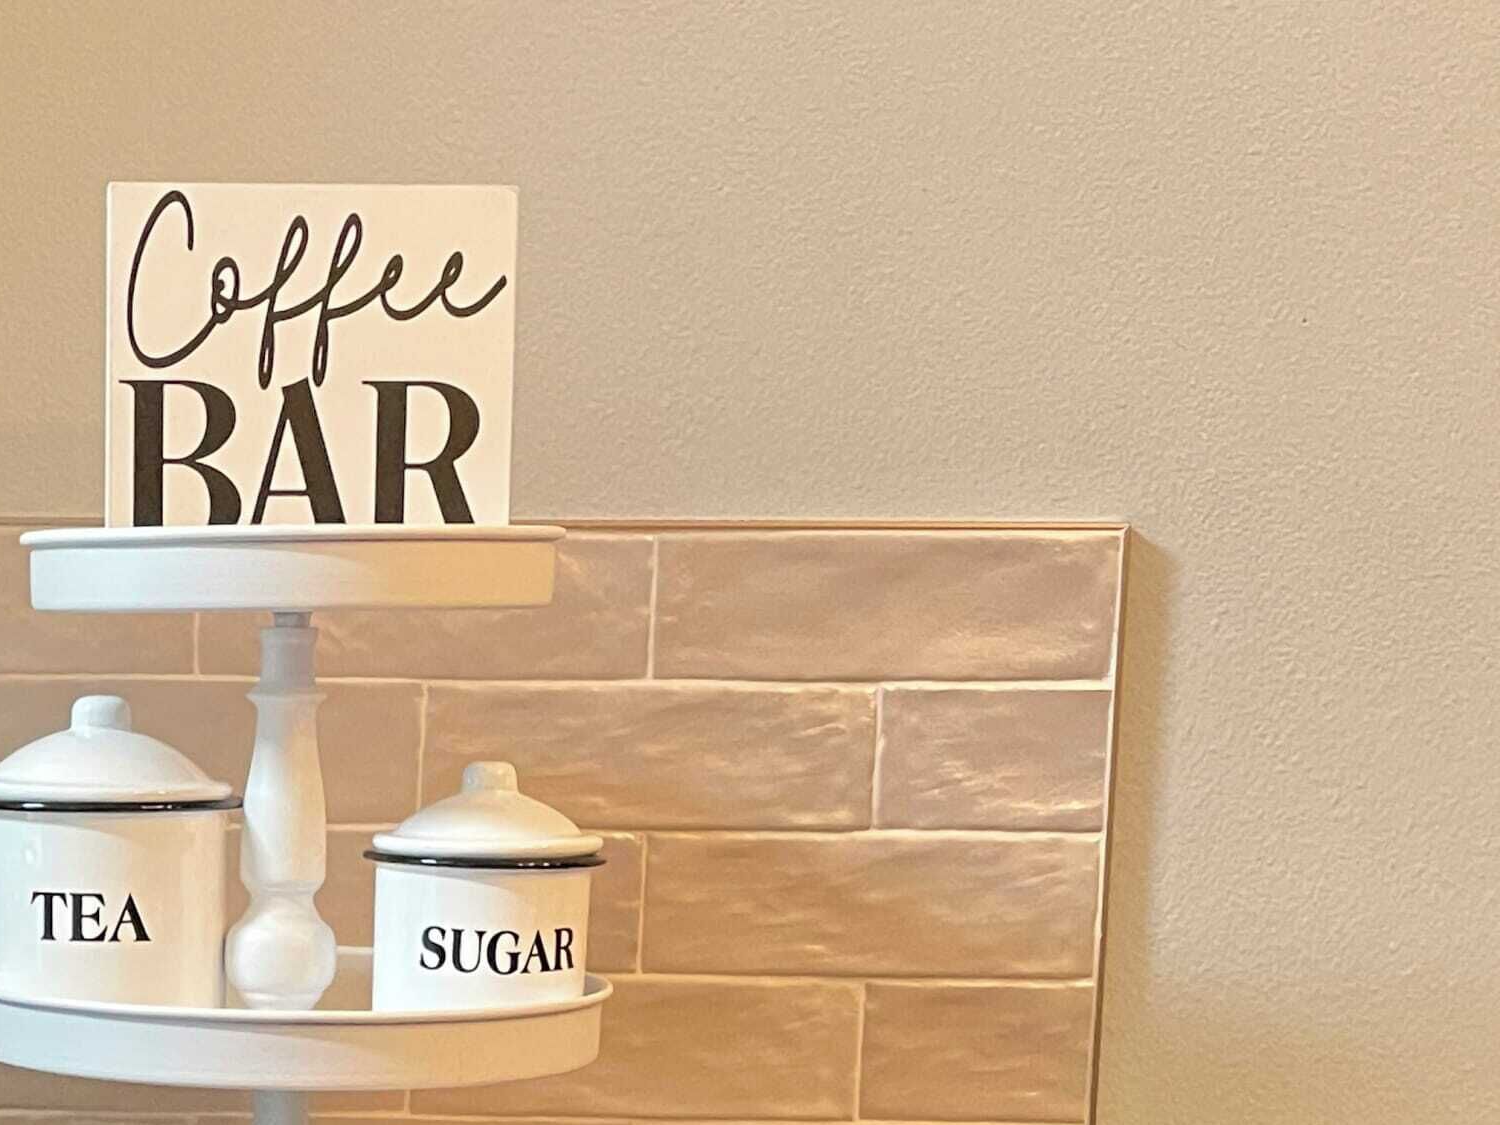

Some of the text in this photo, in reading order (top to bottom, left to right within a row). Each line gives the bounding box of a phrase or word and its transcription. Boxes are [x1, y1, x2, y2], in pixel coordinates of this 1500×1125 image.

[127, 190, 508, 390] Coffee
[118, 377, 480, 527] BAR
[30, 891, 152, 943] TEA
[419, 925, 574, 976] SUGAR
